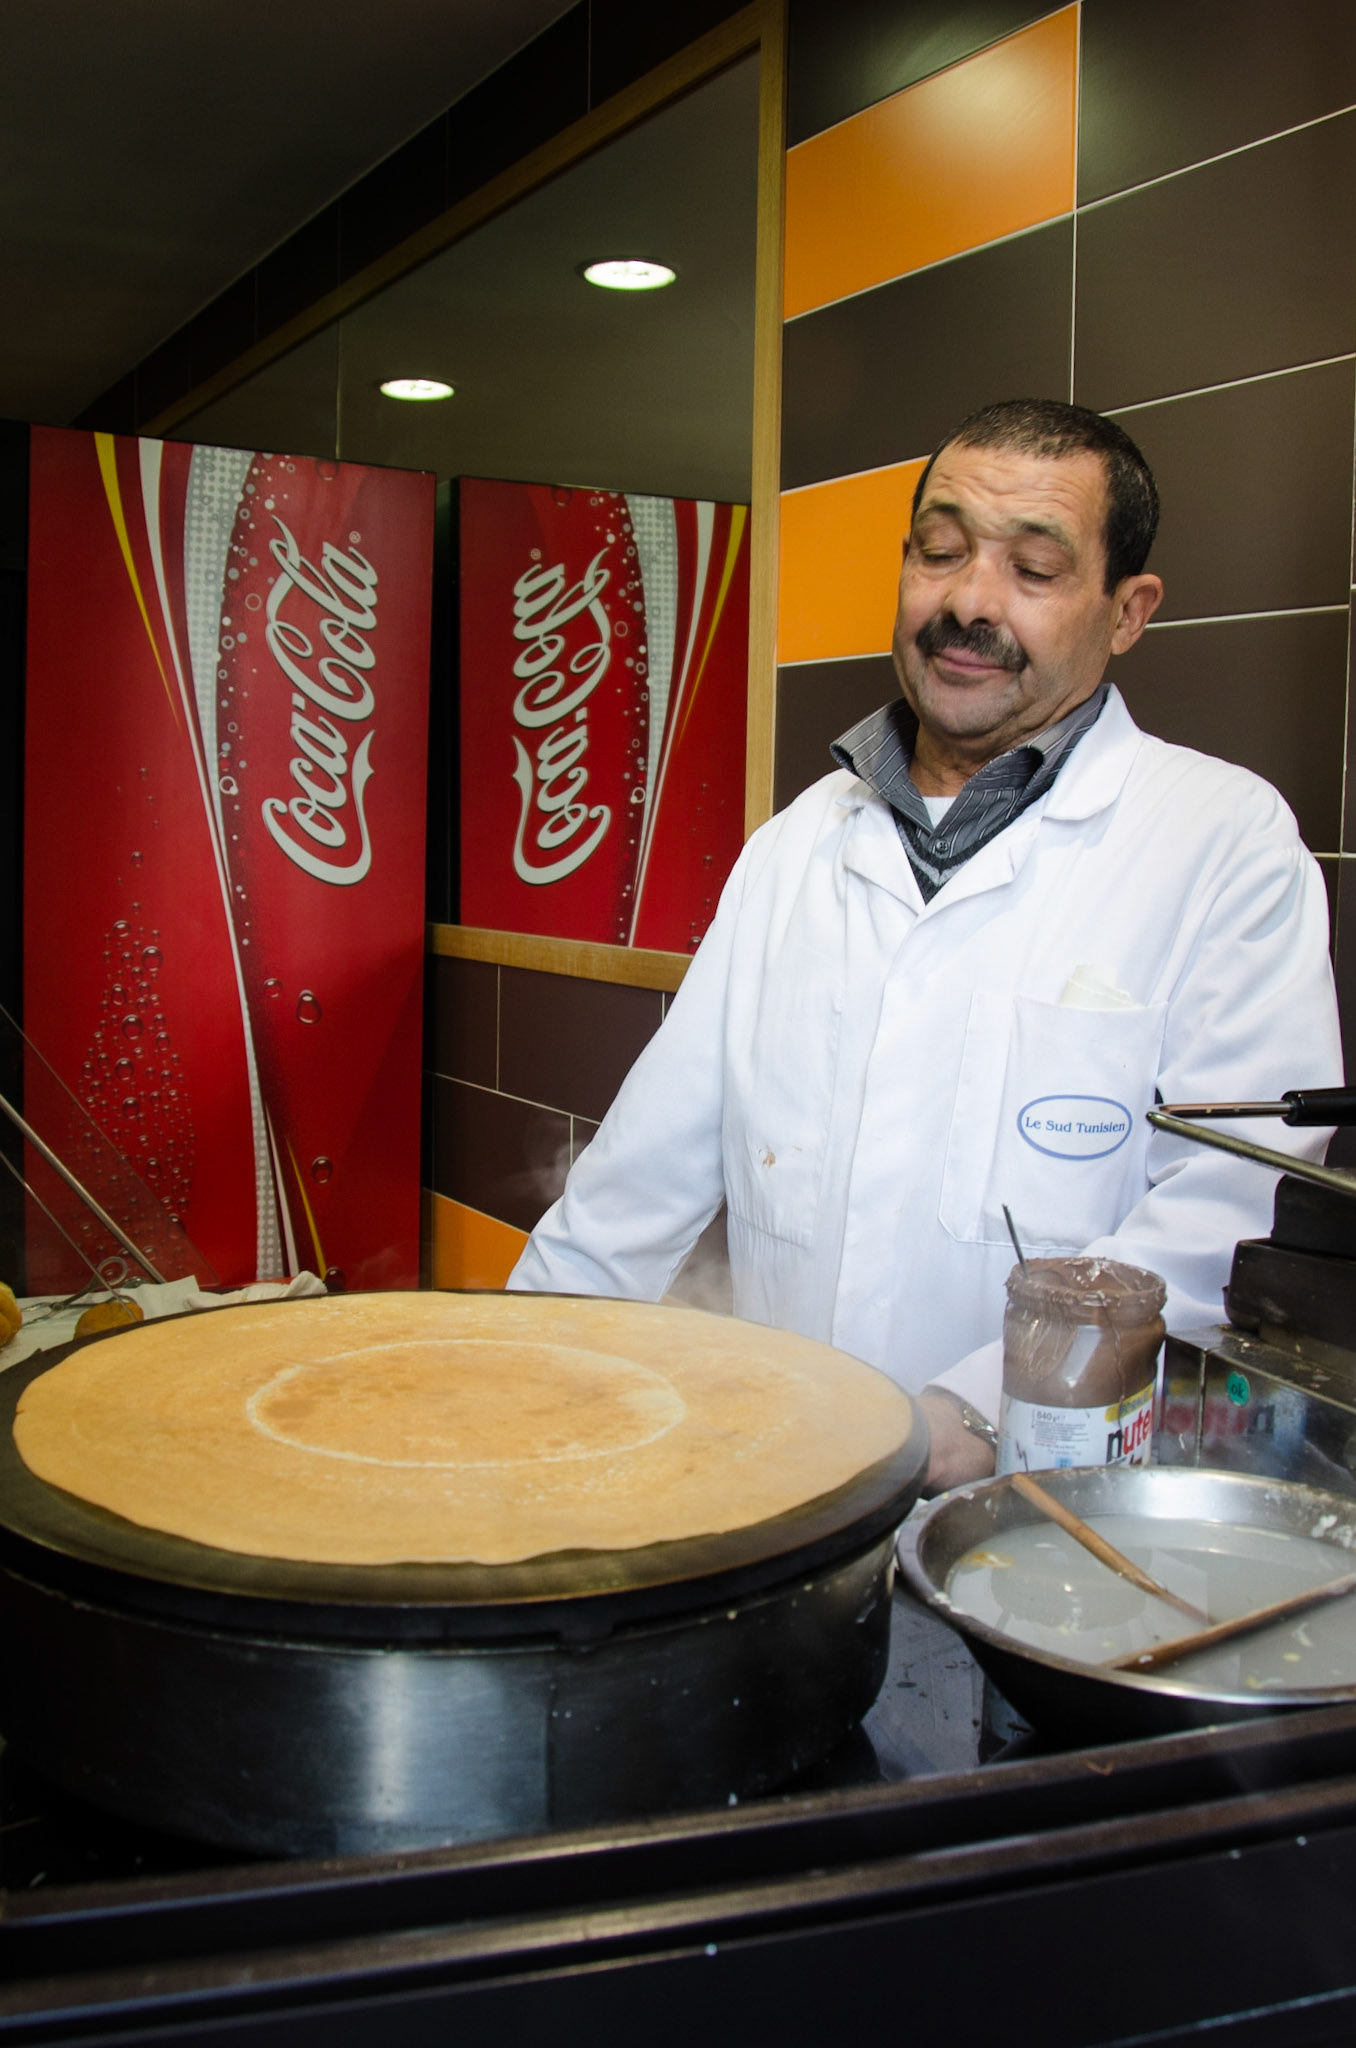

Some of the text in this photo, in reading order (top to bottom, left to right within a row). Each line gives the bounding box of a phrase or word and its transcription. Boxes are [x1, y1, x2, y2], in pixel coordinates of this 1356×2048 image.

[262, 515, 378, 886] Coca-Cola
[1025, 1116, 1126, 1133] Le Sud Tunisien
